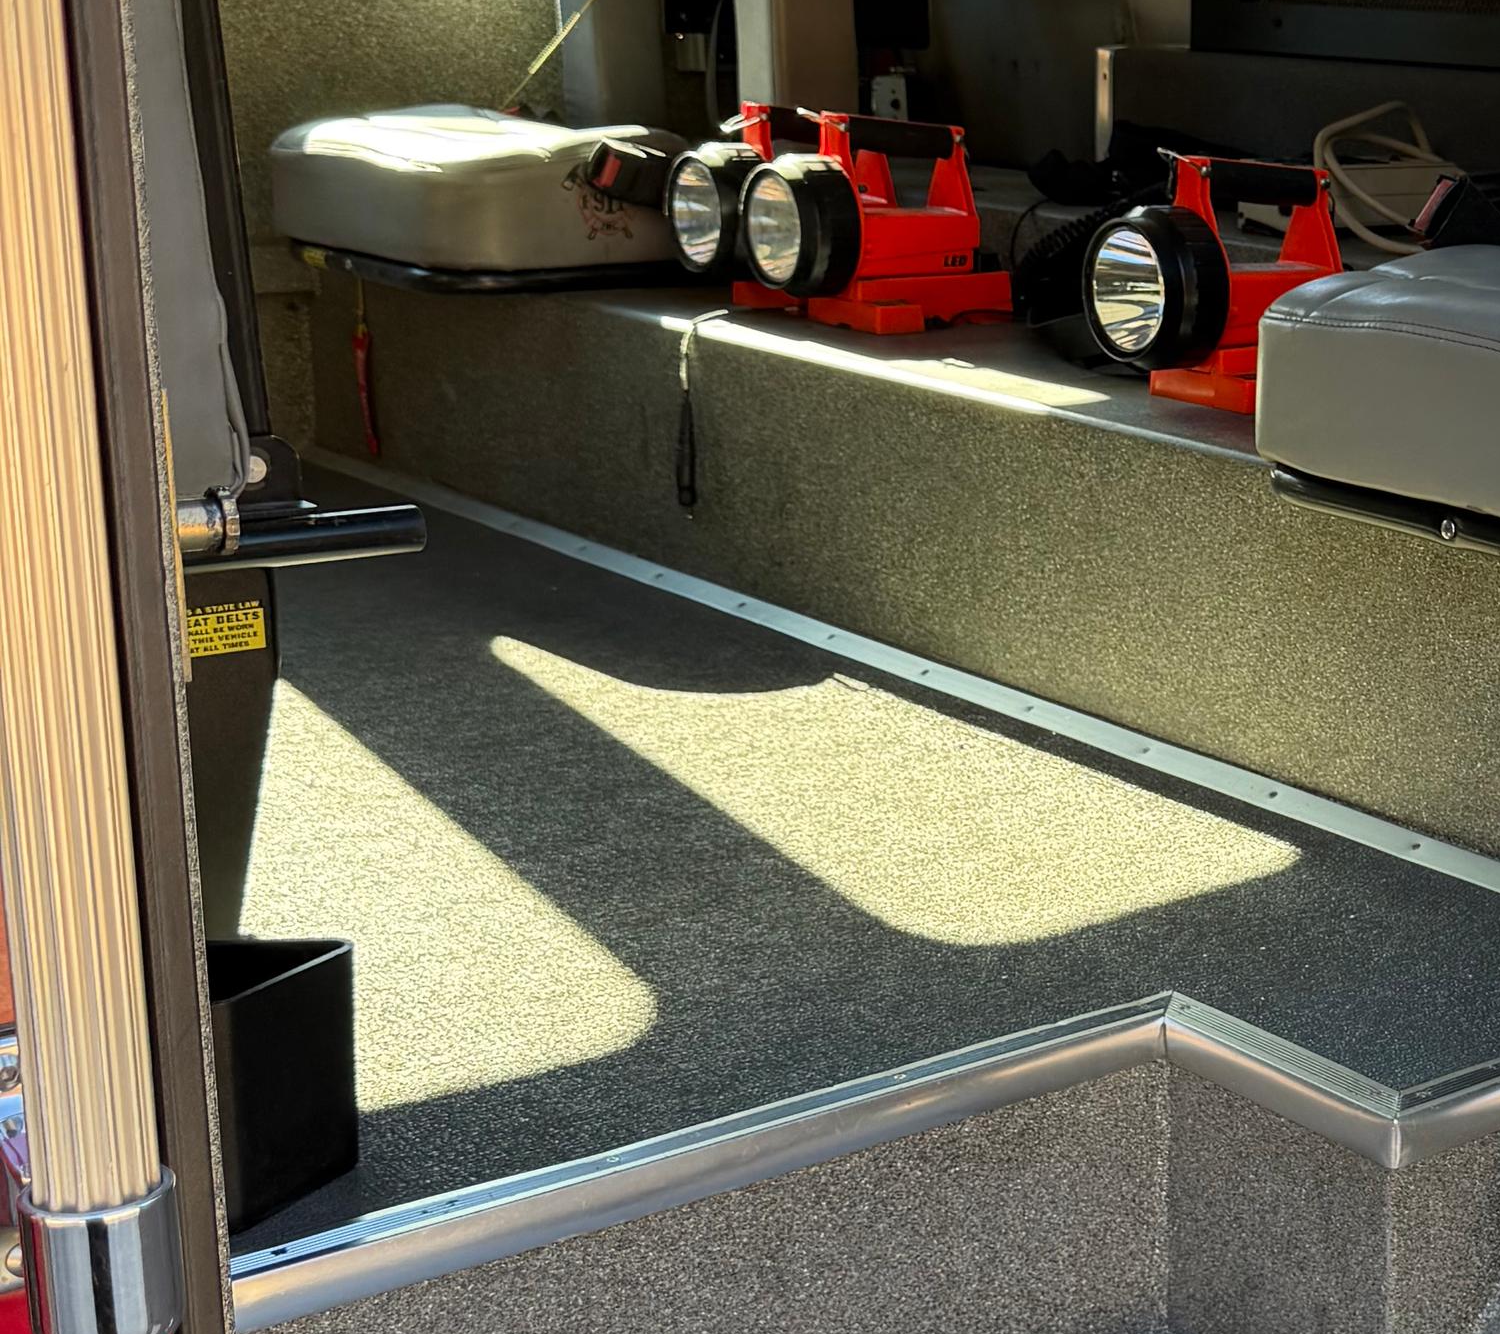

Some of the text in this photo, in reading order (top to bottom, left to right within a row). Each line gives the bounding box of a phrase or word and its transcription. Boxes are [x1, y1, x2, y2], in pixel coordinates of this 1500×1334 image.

[943, 255, 968, 267] LED
[205, 603, 236, 613] STATE
[238, 600, 260, 609] LAW
[187, 611, 260, 629] EAT BELTS
[218, 631, 258, 642] VEHICLE
